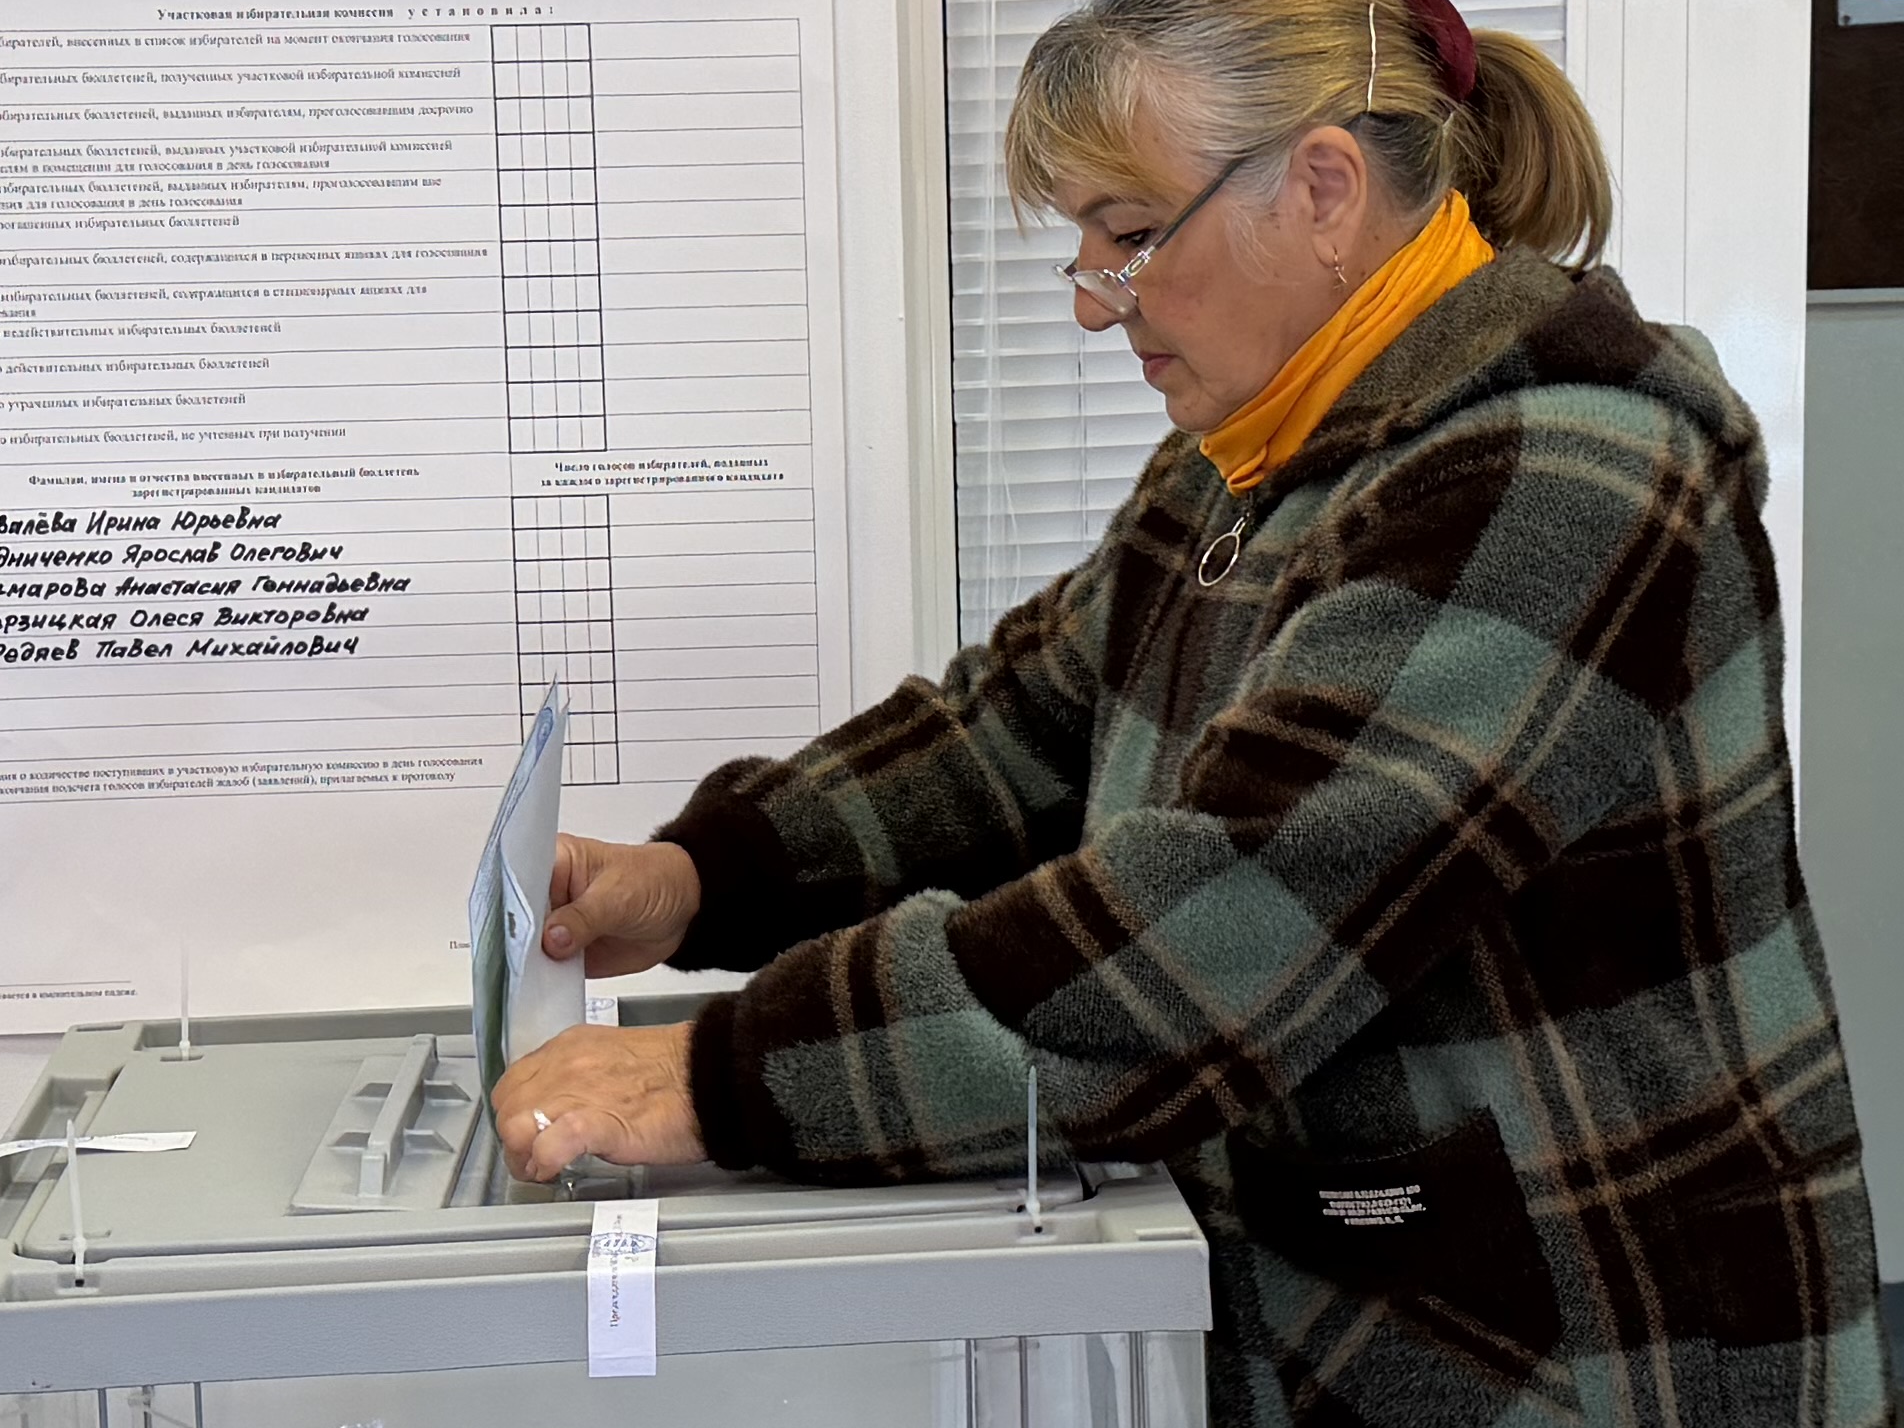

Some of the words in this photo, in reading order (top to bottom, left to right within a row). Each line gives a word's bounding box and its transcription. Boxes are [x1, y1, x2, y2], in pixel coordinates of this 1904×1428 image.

[157, 9, 231, 20] Участковая
[236, 9, 329, 20] избирательная
[334, 9, 392, 18] комиссия
[85, 510, 161, 535] Ирина
[171, 506, 282, 535] Юрьевна
[122, 541, 222, 569] Ярослав
[230, 542, 344, 563] Олегович
[114, 575, 242, 597] Анастасия
[251, 571, 411, 593] Геннадьевна
[130, 609, 204, 627] Олеся
[214, 602, 370, 629] Викторовна
[96, 638, 173, 659] Павел
[185, 635, 359, 657] Михайлович
